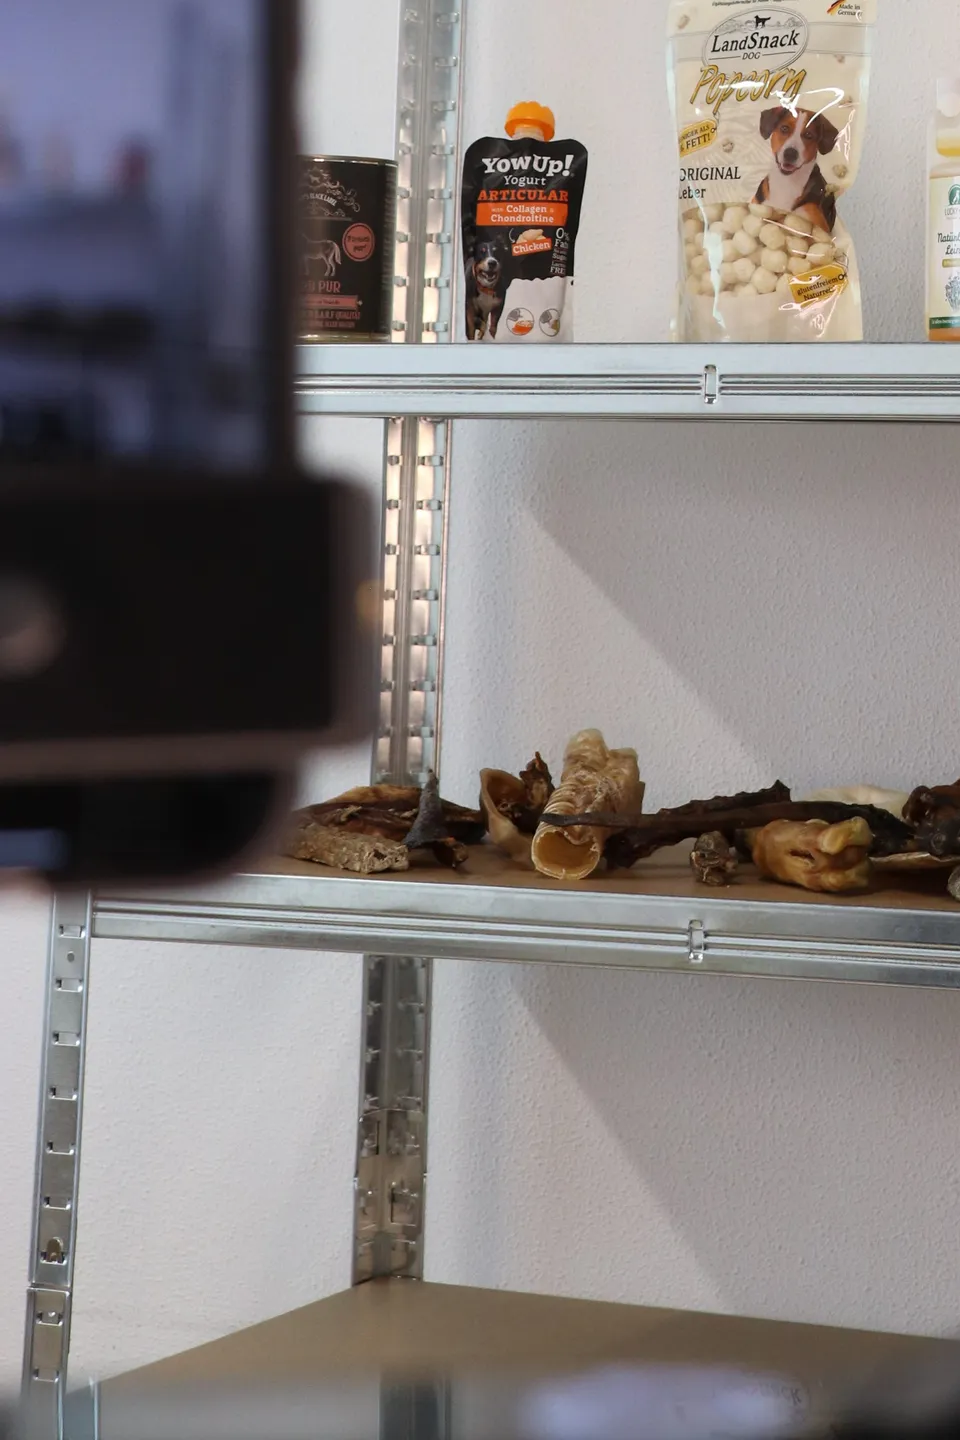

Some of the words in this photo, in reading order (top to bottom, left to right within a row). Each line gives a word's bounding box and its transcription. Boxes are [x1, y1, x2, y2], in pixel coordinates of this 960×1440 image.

[711, 29, 800, 52] LandSnack
[742, 51, 761, 60] DOG
[690, 64, 807, 116] Popcorn
[686, 133, 711, 150] FETT!
[504, 174, 546, 187] Yogurt
[680, 166, 742, 182] ORIGINAL
[477, 189, 569, 202] ARTICULAR
[506, 204, 547, 215] Collagen
[490, 213, 554, 223] Chondroitine
[512, 241, 551, 255] Chicken
[319, 280, 341, 293] PUR
